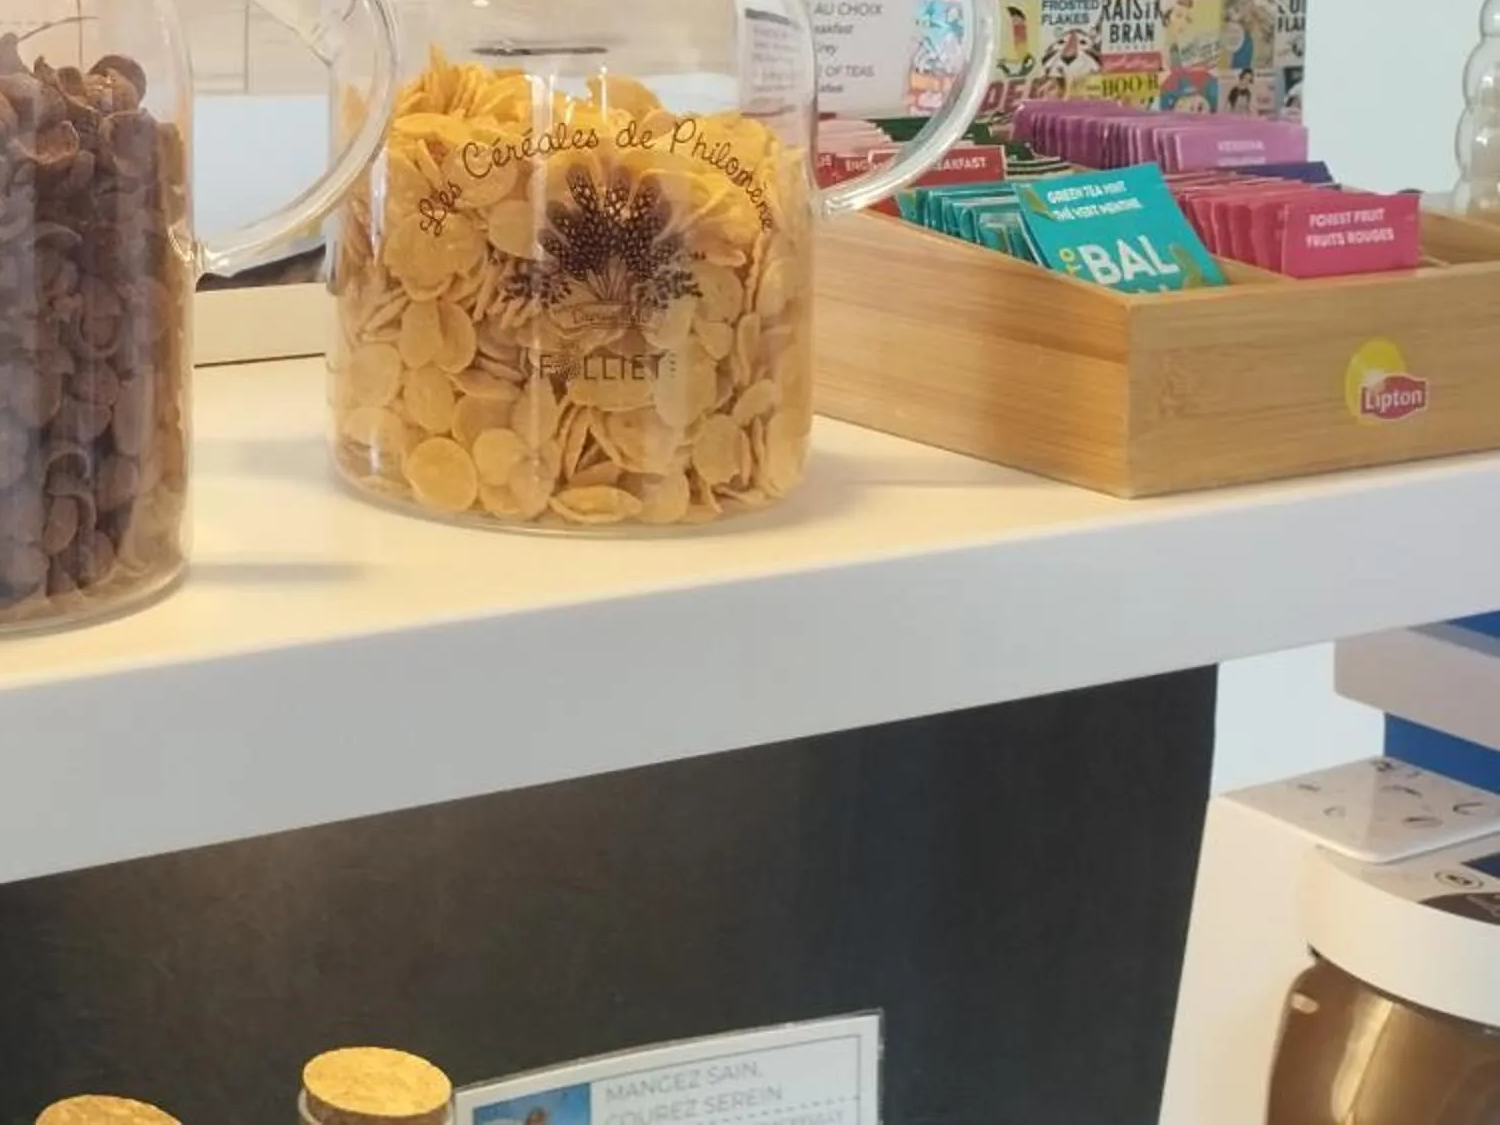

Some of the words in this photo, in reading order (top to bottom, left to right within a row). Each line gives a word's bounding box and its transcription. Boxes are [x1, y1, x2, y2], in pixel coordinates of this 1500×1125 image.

[1041, 12, 1090, 24] FLAKES
[1109, 24, 1155, 44] BRAN
[462, 122, 599, 179] Céréales
[615, 121, 653, 149] de
[1309, 211, 1352, 228] FOREST
[1353, 208, 1385, 223] FRUIT
[1305, 233, 1345, 249] FRUITS
[1347, 227, 1395, 244] ROUGES
[1076, 234, 1181, 285] BAL
[1364, 388, 1423, 413] Lipton
